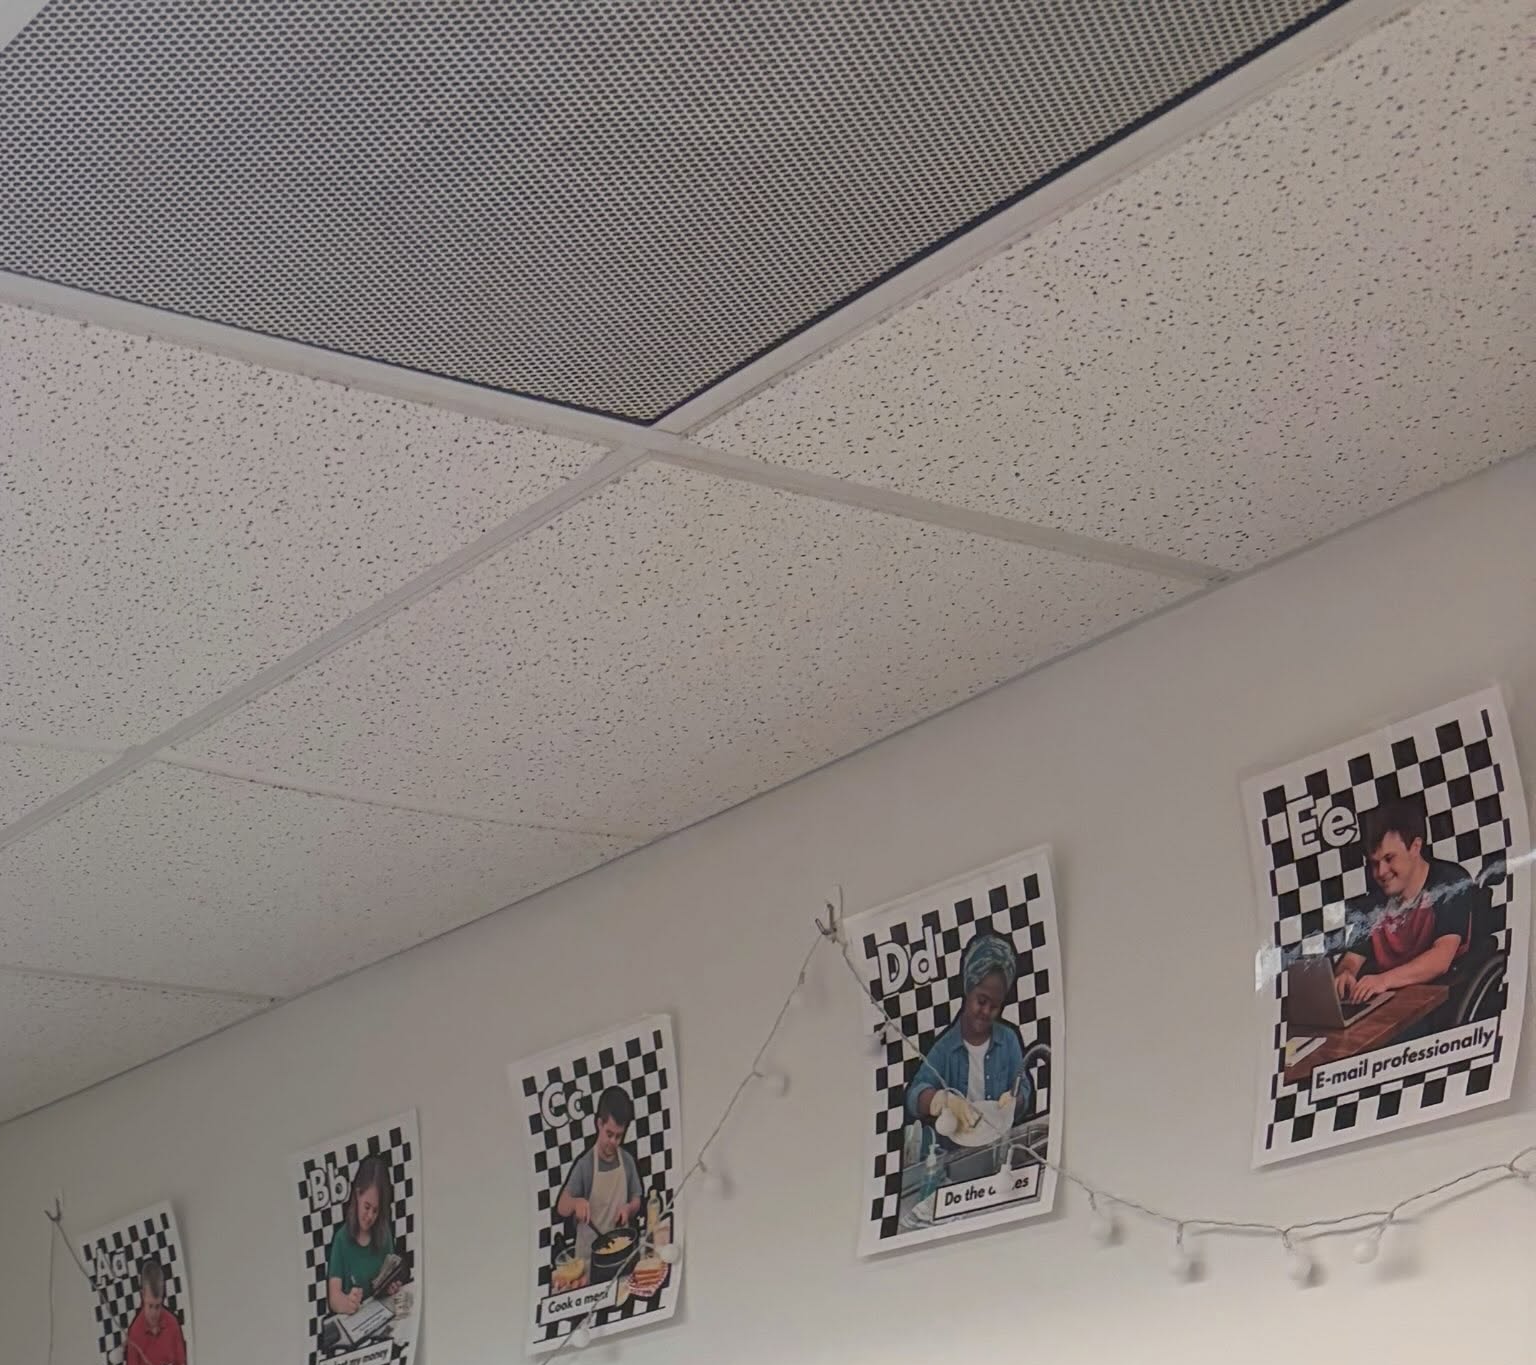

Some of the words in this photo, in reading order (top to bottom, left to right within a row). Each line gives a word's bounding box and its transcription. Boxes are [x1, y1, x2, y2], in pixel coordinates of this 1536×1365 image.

[1286, 795, 1359, 860] Ee
[877, 926, 938, 998] Dd
[1316, 1060, 1368, 1089] E-mail
[1371, 1027, 1494, 1079] professionally
[541, 1081, 586, 1128] Cc
[310, 1163, 351, 1210] Bb
[944, 1191, 962, 1207] Do
[965, 1185, 985, 1202] the
[95, 1248, 128, 1289] Aa
[548, 1296, 573, 1314] Cook
[575, 1298, 582, 1307] a
